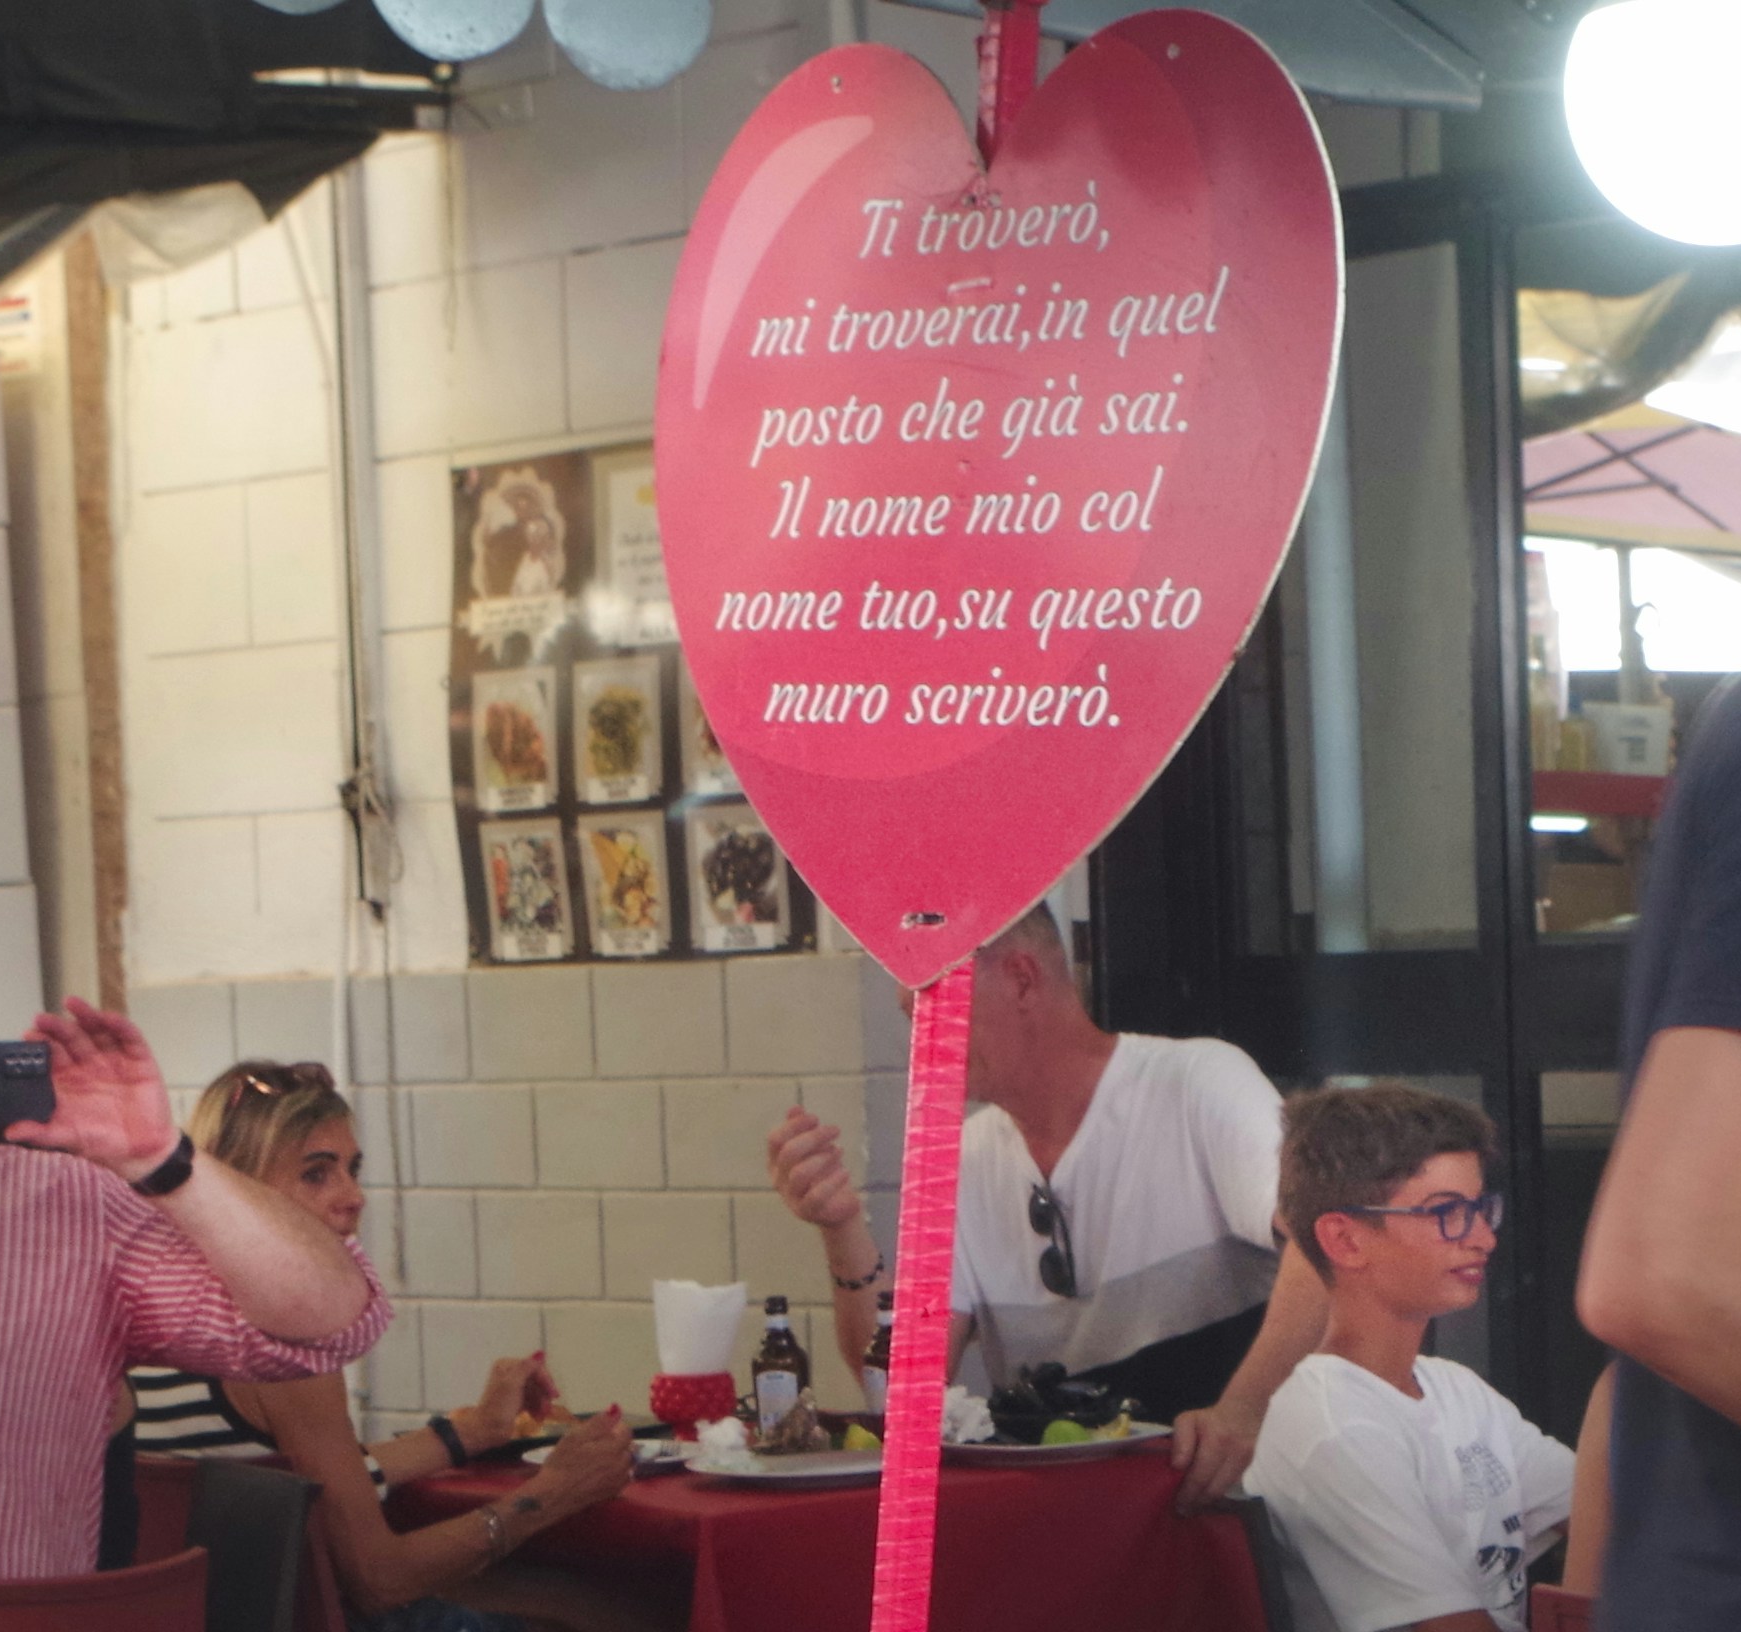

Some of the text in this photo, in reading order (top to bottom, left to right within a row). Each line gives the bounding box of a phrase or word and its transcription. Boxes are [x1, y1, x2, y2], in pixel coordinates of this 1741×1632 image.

[860, 181, 1108, 257] Ti troverò,
[752, 299, 815, 356] mi
[1110, 266, 1228, 356] quel
[751, 374, 1187, 467] posto che già sai.
[770, 465, 1163, 538] Il nome mio col
[716, 591, 840, 630] nome
[1030, 578, 1201, 649] questo
[764, 664, 1119, 726] muro scriverò.
